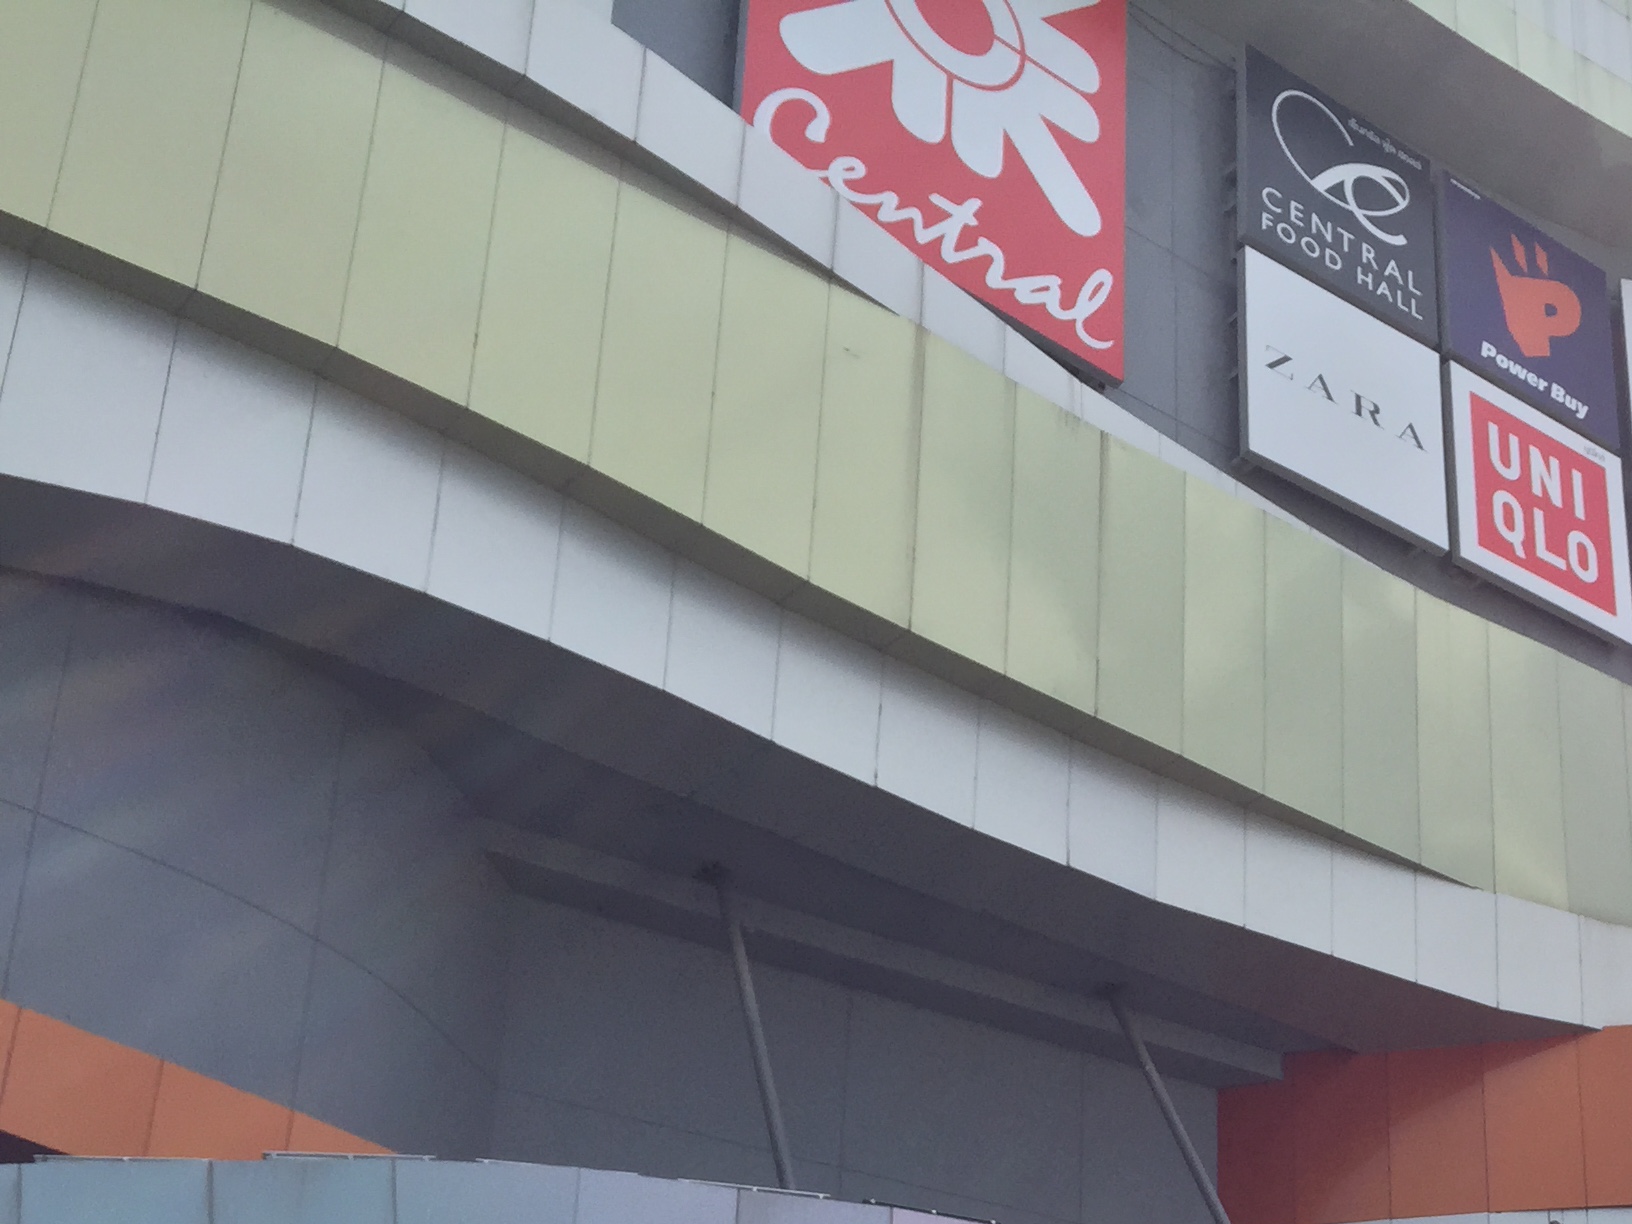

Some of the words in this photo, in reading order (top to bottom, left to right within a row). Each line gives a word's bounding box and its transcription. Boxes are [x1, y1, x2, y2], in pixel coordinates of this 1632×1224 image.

[753, 87, 1113, 350] Central
[1261, 187, 1424, 297] CENTRAL
[1261, 211, 1342, 271] FOOD
[1356, 265, 1424, 321] HALL
[1264, 344, 1428, 453] ZARA
[1480, 340, 1548, 393] Power
[1551, 380, 1590, 419] Buy
[1487, 420, 1587, 520] UNI
[1491, 489, 1599, 585] QLO
